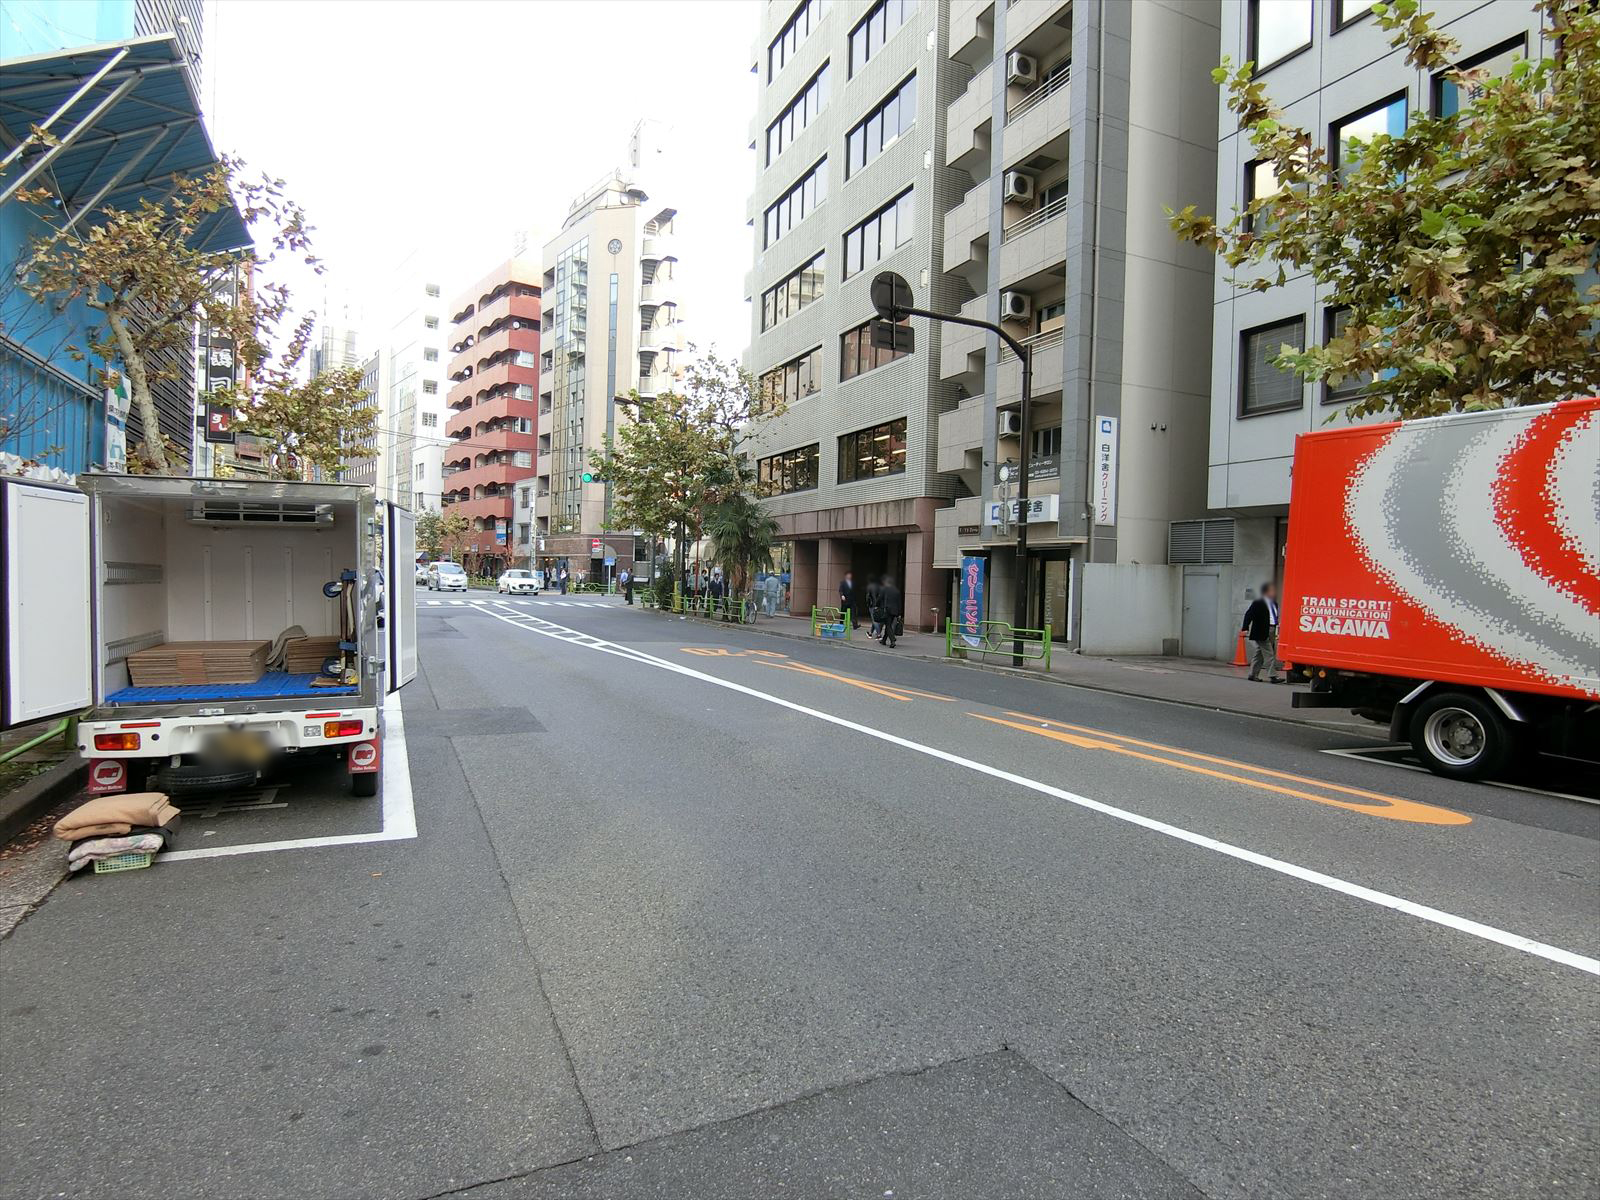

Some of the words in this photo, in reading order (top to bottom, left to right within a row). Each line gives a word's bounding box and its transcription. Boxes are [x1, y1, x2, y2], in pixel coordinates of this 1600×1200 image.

[211, 413, 228, 431] すし
[1302, 607, 1388, 619] COMMUNICATION
[1299, 616, 1390, 639] SAGAWA
